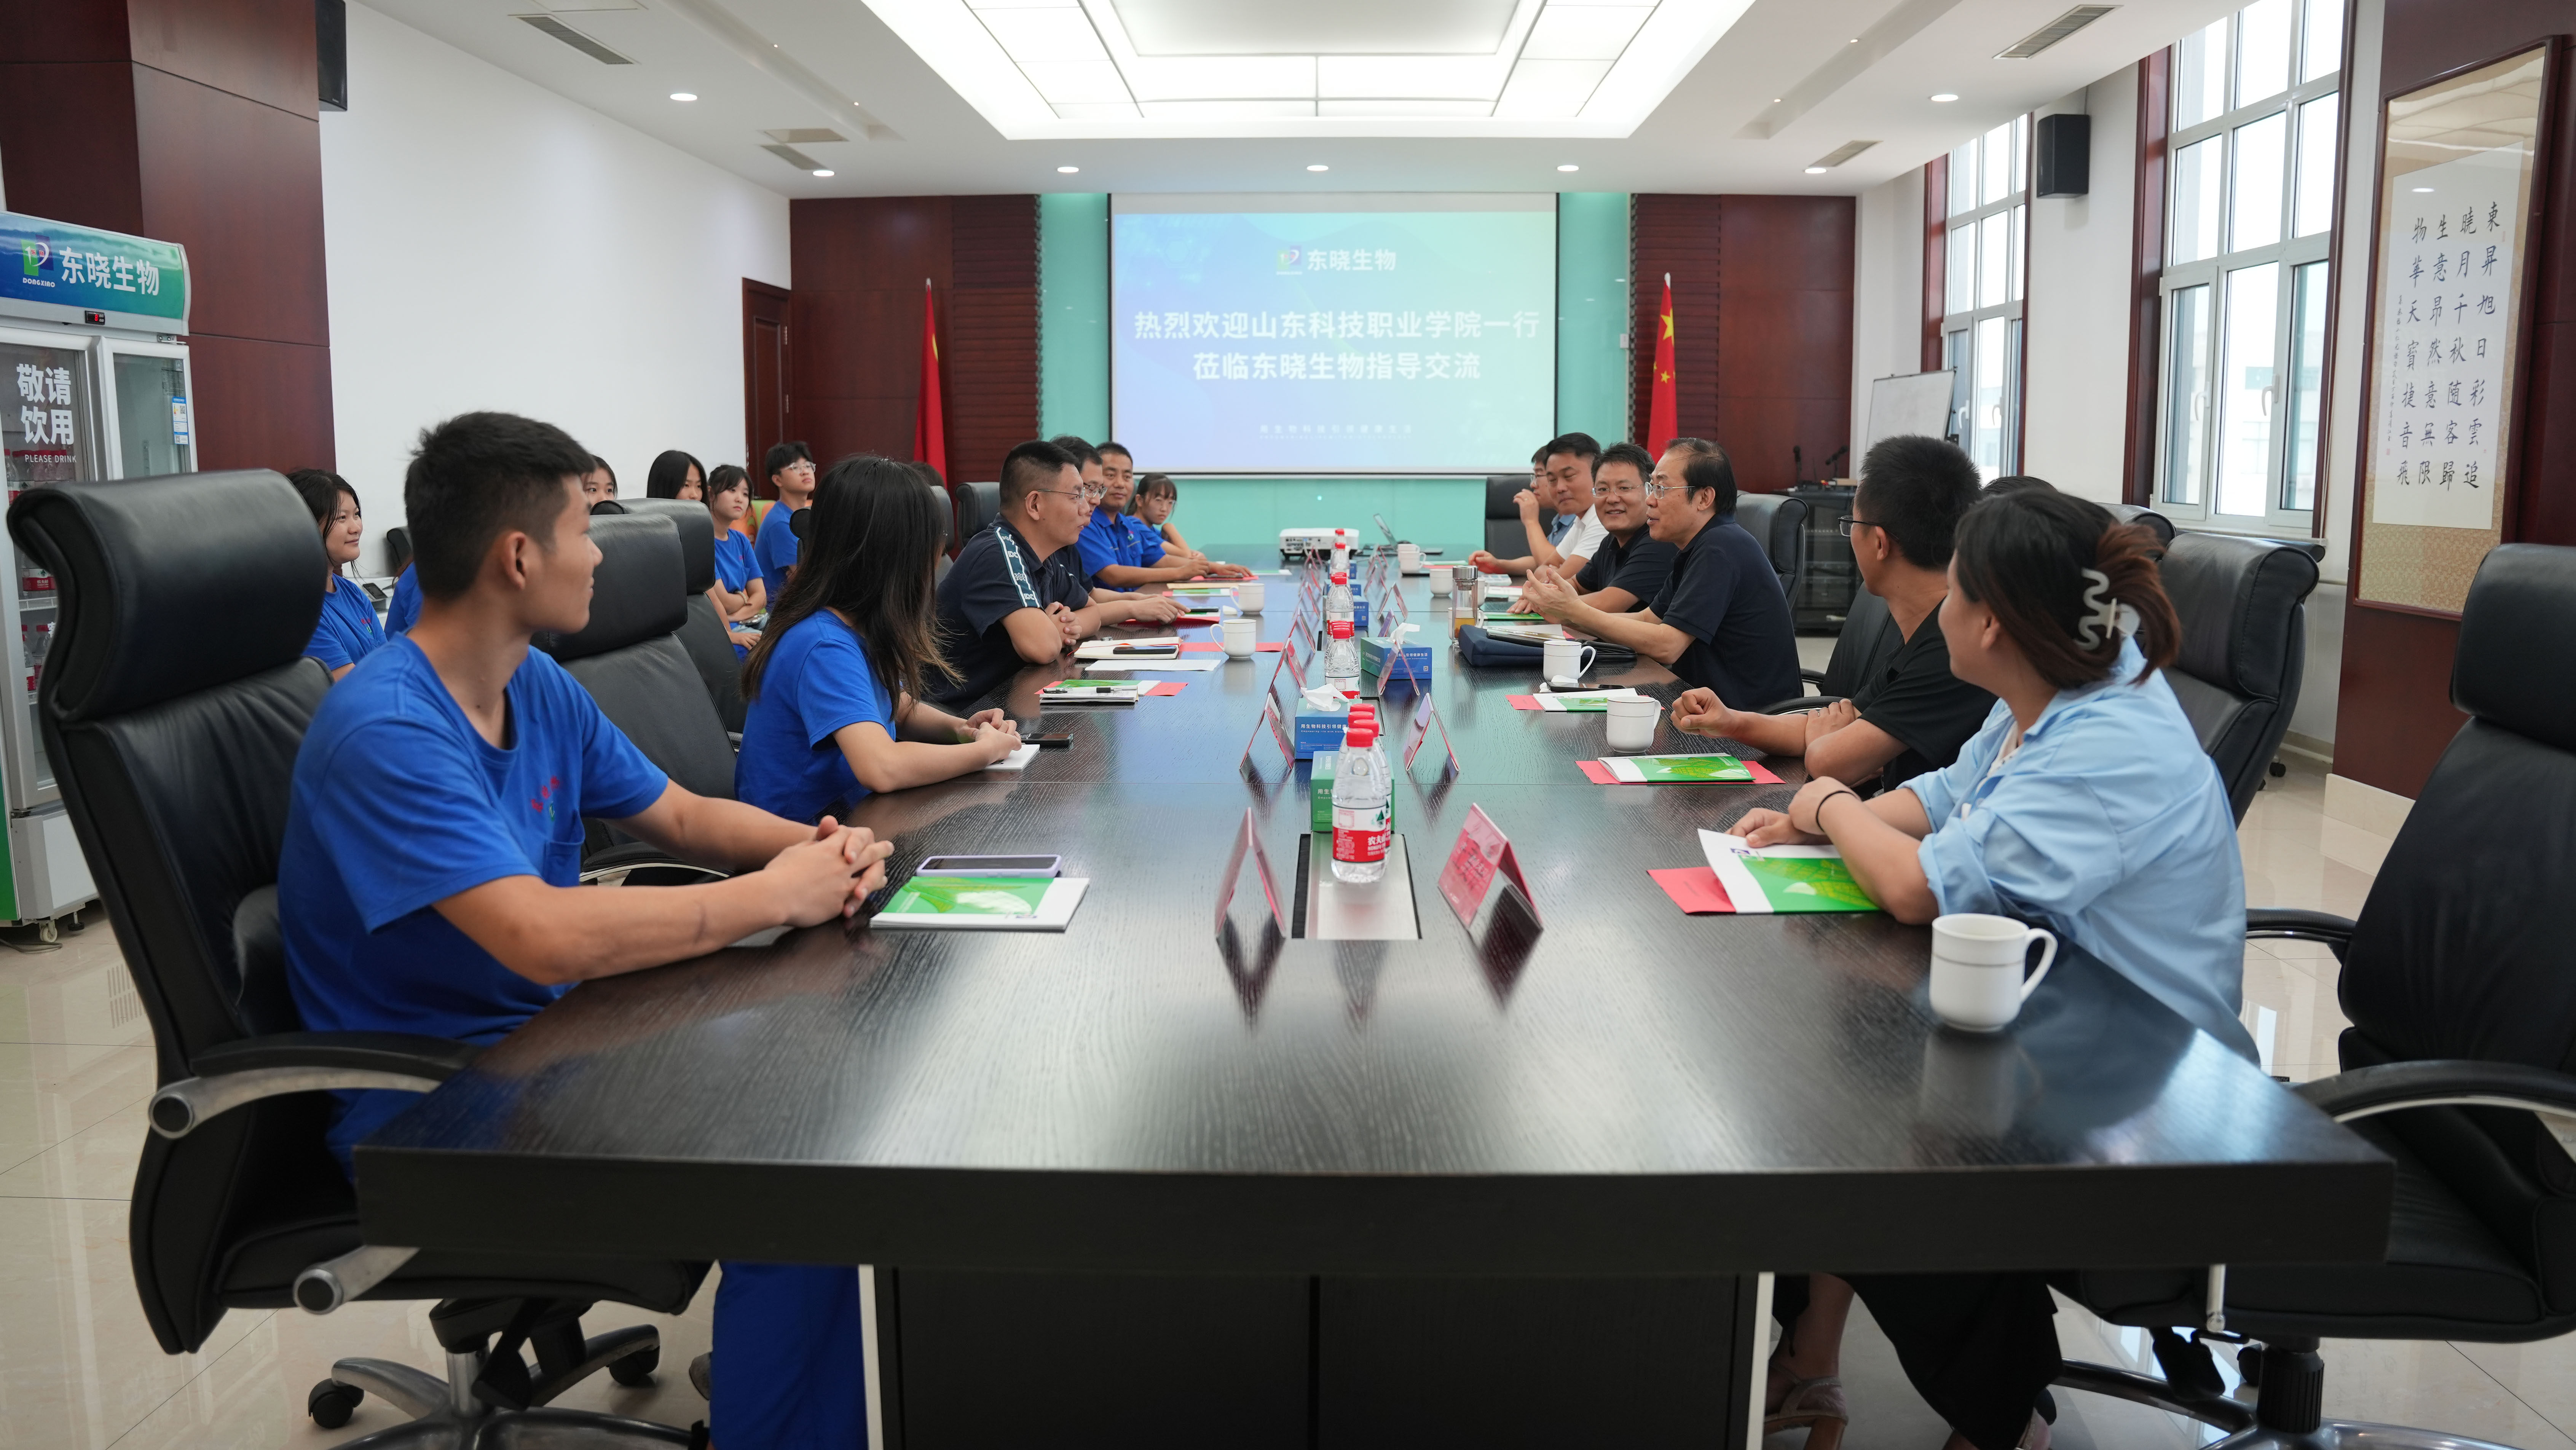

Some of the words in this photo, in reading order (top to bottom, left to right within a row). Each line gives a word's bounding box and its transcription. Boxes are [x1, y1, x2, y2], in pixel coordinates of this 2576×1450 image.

[59, 246, 160, 296] 东晓生物
[1307, 249, 1397, 271] 东晓生物
[1134, 310, 1540, 339] 热烈欢迎山东科技职业学院一行
[1193, 352, 1480, 380] 莅临东晓生物指导交流
[16, 363, 71, 405] 敬请
[21, 405, 74, 445] 饮用
[25, 454, 52, 463] PLEASE
[55, 454, 77, 463] DRINK
